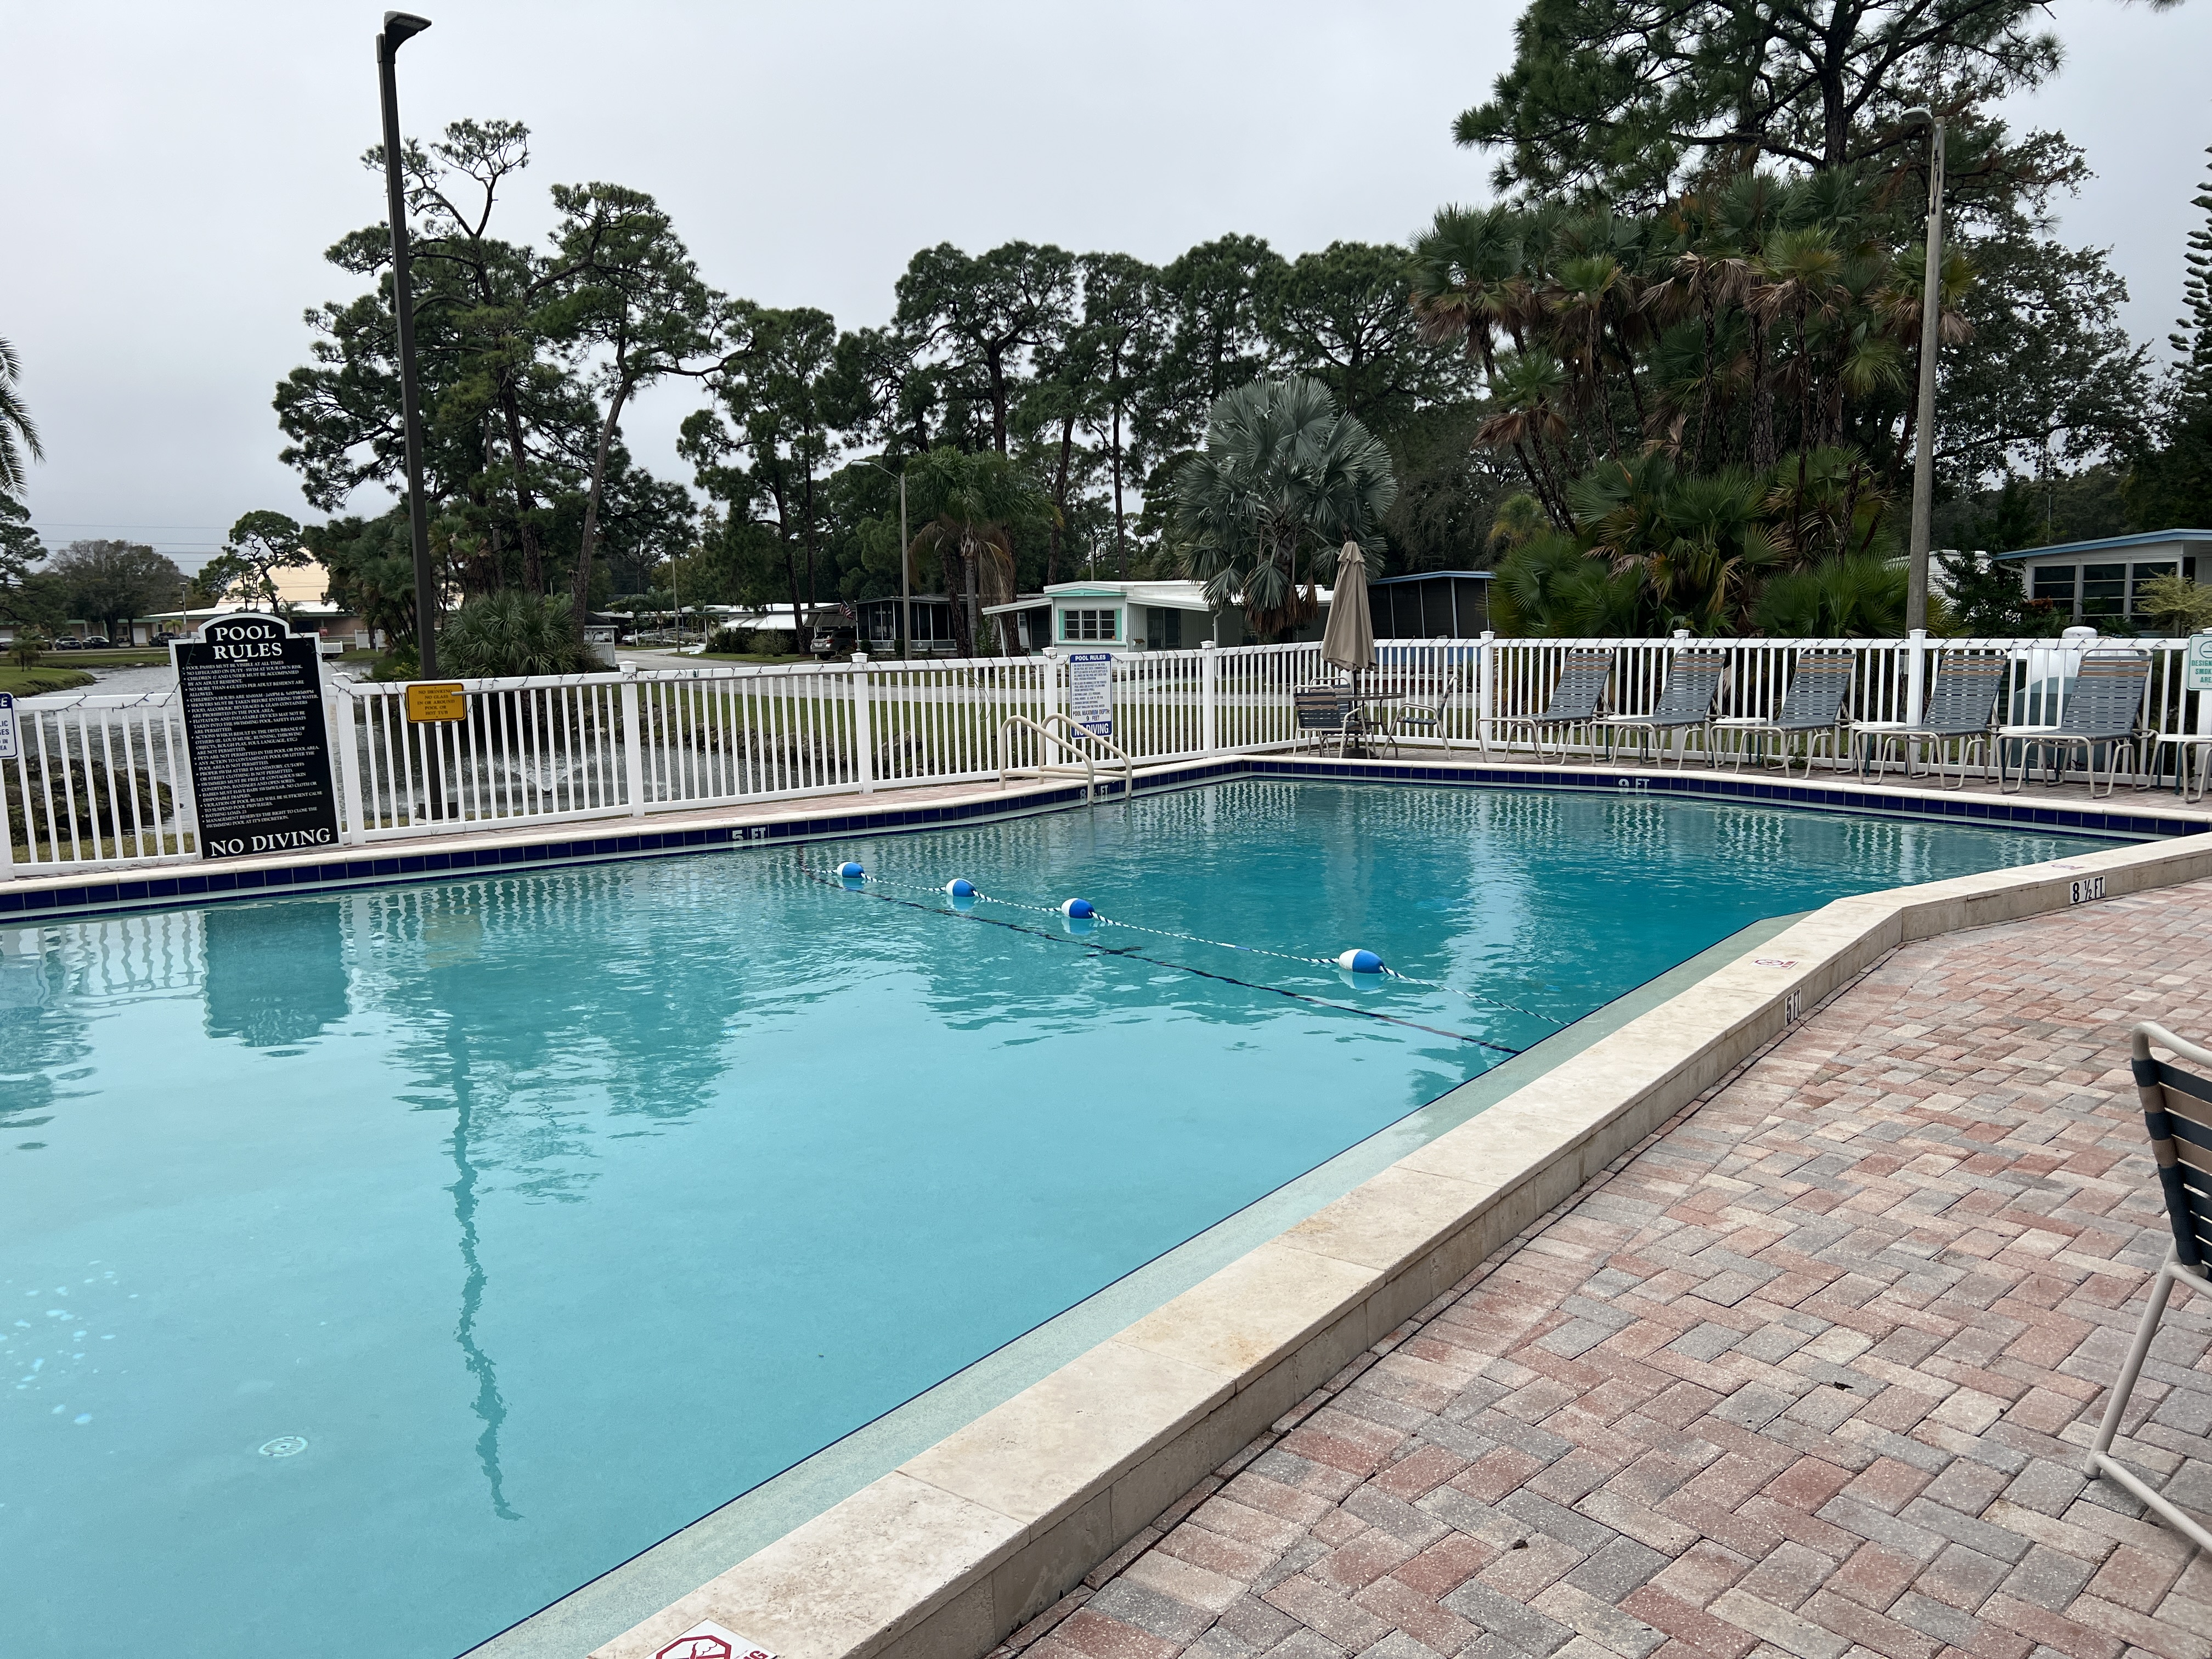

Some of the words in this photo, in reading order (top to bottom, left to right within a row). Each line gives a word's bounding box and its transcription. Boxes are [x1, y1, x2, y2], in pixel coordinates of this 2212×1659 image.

[215, 625, 276, 641] POOL
[212, 643, 283, 659] RULES
[1086, 723, 1109, 735] DIVING
[1618, 778, 1629, 788] 9
[1635, 778, 1650, 789] FT
[732, 830, 743, 840] 5
[751, 827, 766, 839] FT
[209, 838, 244, 856] NO
[251, 828, 331, 851] DIVING
[2073, 882, 2080, 902] 8
[1786, 996, 1792, 1024] 5
